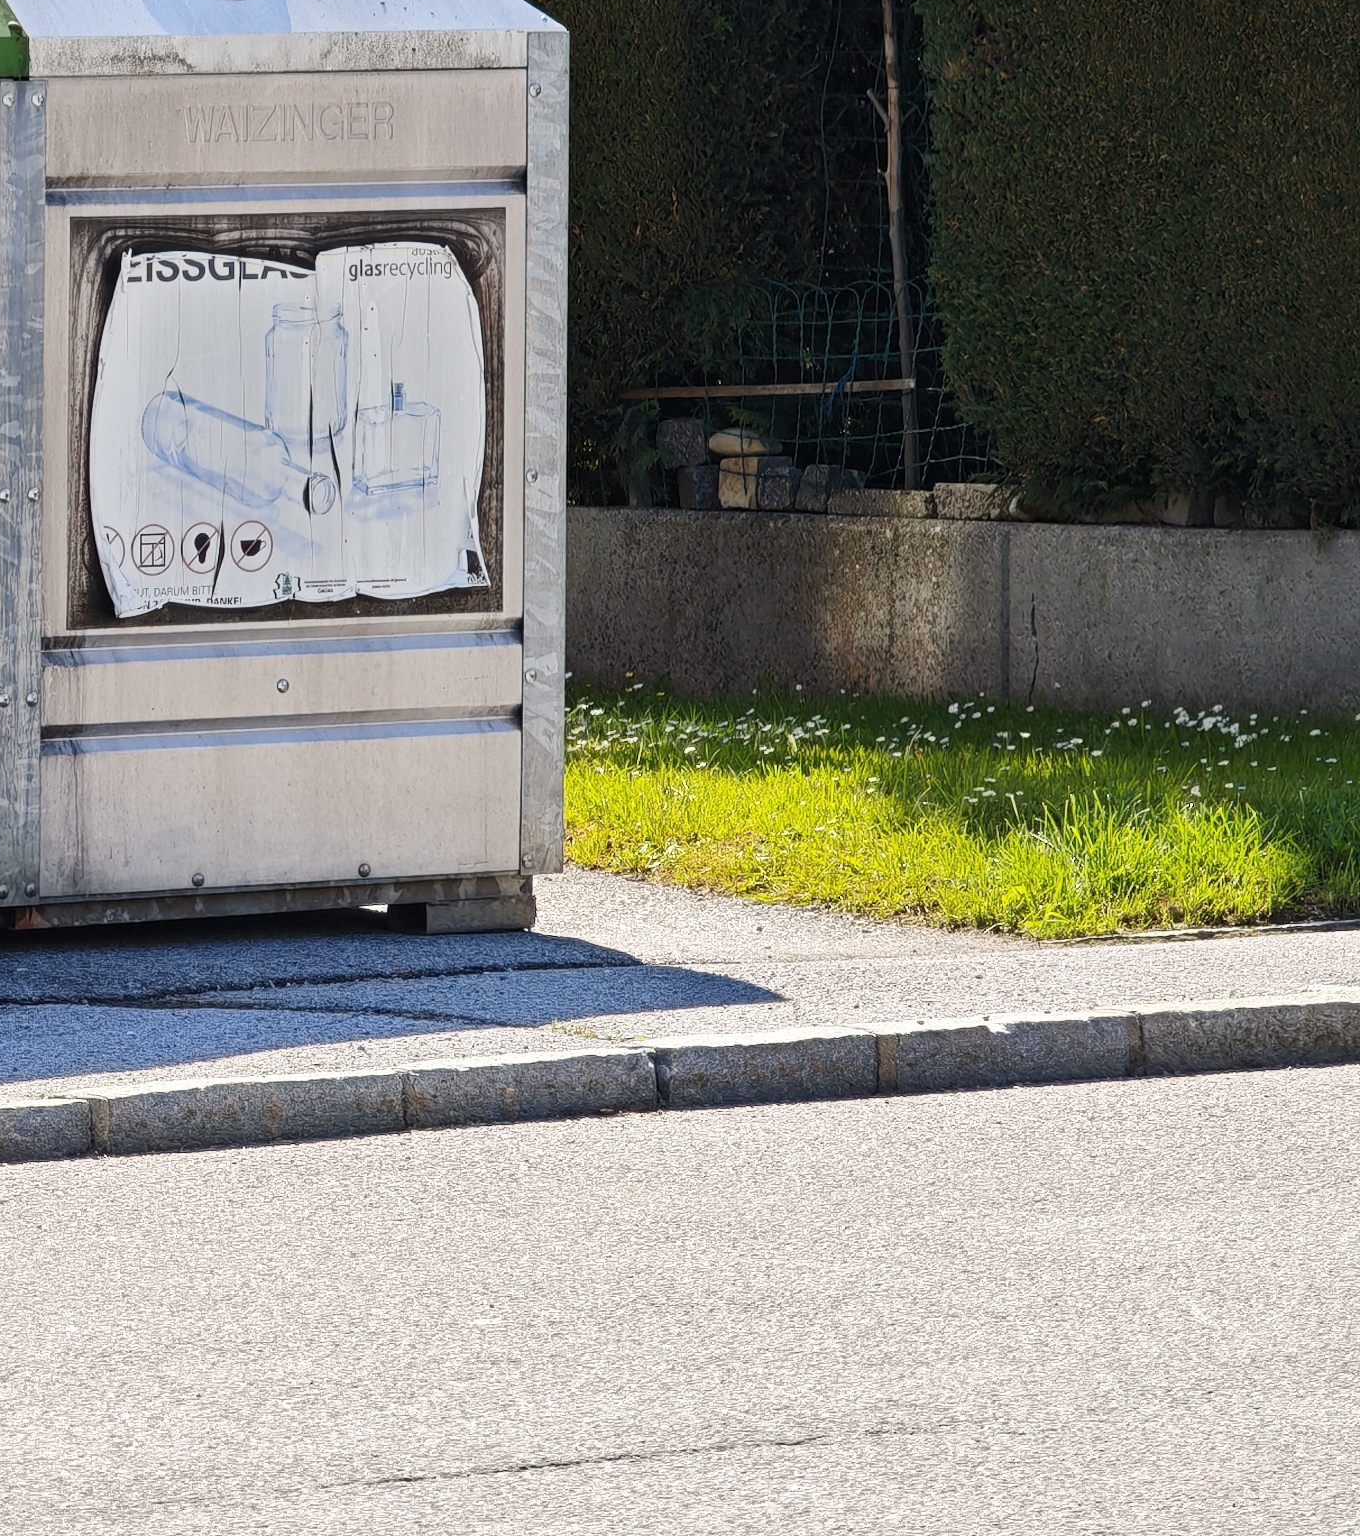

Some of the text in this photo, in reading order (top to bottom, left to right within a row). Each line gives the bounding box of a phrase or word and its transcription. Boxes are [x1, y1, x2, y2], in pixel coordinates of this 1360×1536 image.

[182, 100, 396, 144] WAIZINGER
[348, 256, 453, 282] glasrecycling
[154, 586, 190, 597] DARUM
